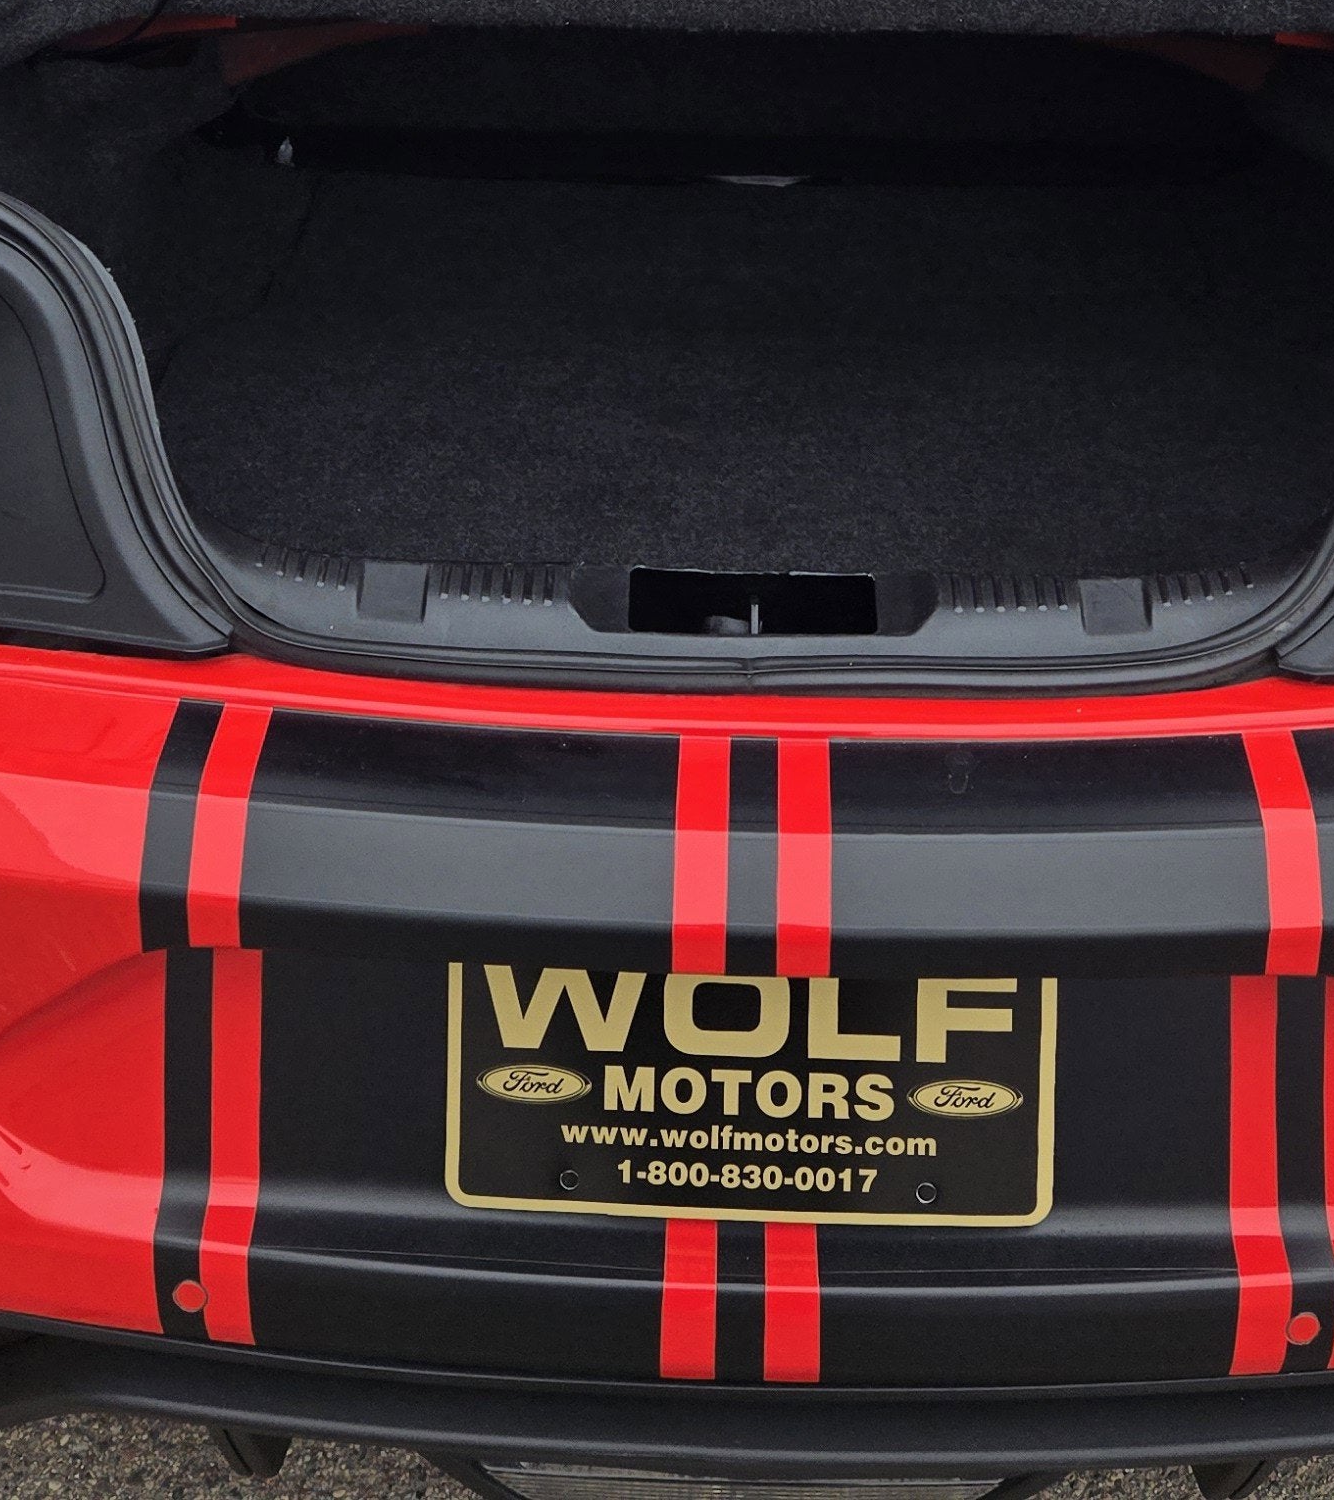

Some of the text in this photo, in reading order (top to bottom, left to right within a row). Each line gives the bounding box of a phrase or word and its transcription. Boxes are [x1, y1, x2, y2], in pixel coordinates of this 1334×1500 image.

[483, 964, 1019, 1063] WOLF
[502, 1070, 565, 1094] Ford
[603, 1065, 896, 1122] MOTORS
[933, 1085, 997, 1109] Ford
[560, 1124, 938, 1157] www.wolfmotors.com
[617, 1160, 878, 1193] 1-800-830-0017
